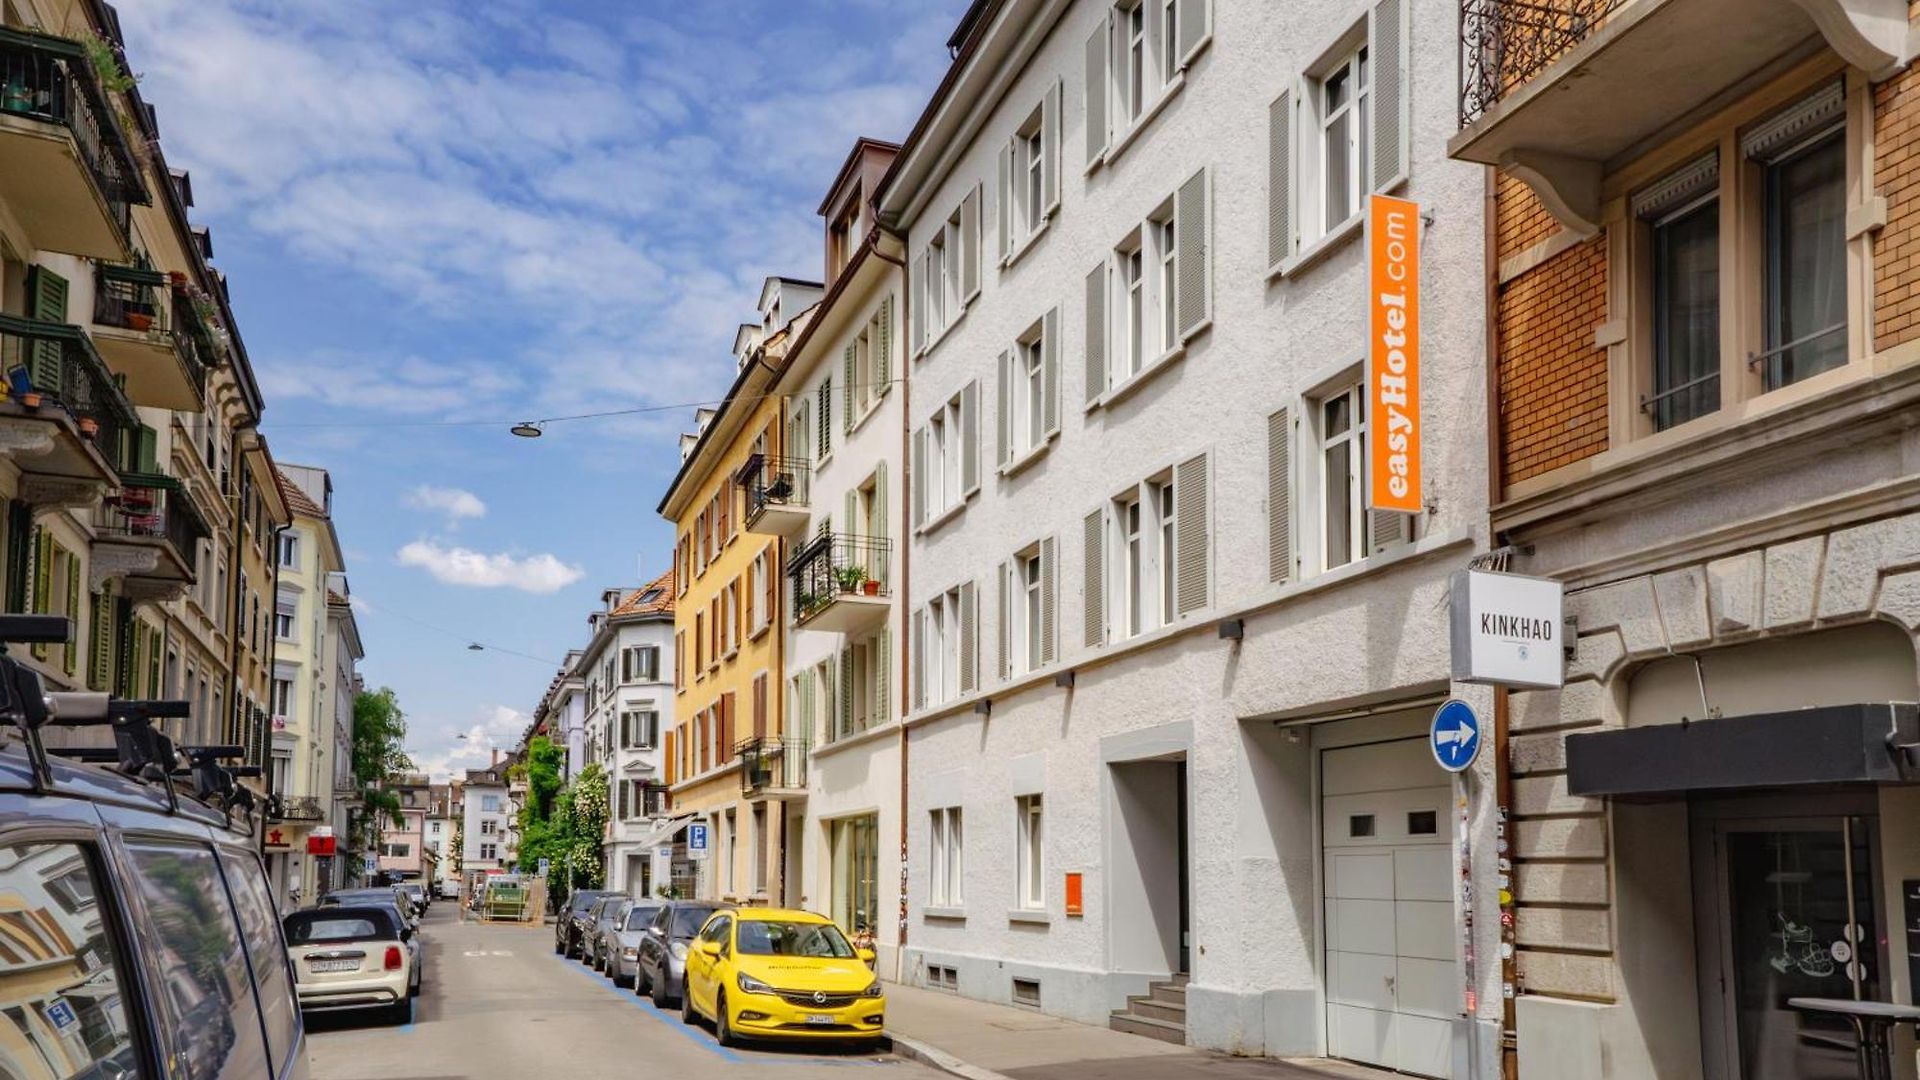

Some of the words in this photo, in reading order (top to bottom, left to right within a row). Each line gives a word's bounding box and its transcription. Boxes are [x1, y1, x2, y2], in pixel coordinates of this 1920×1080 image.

[1381, 211, 1412, 498] easyHotel.com
[1481, 612, 1552, 641] KINKHAO
[694, 826, 704, 840] P
